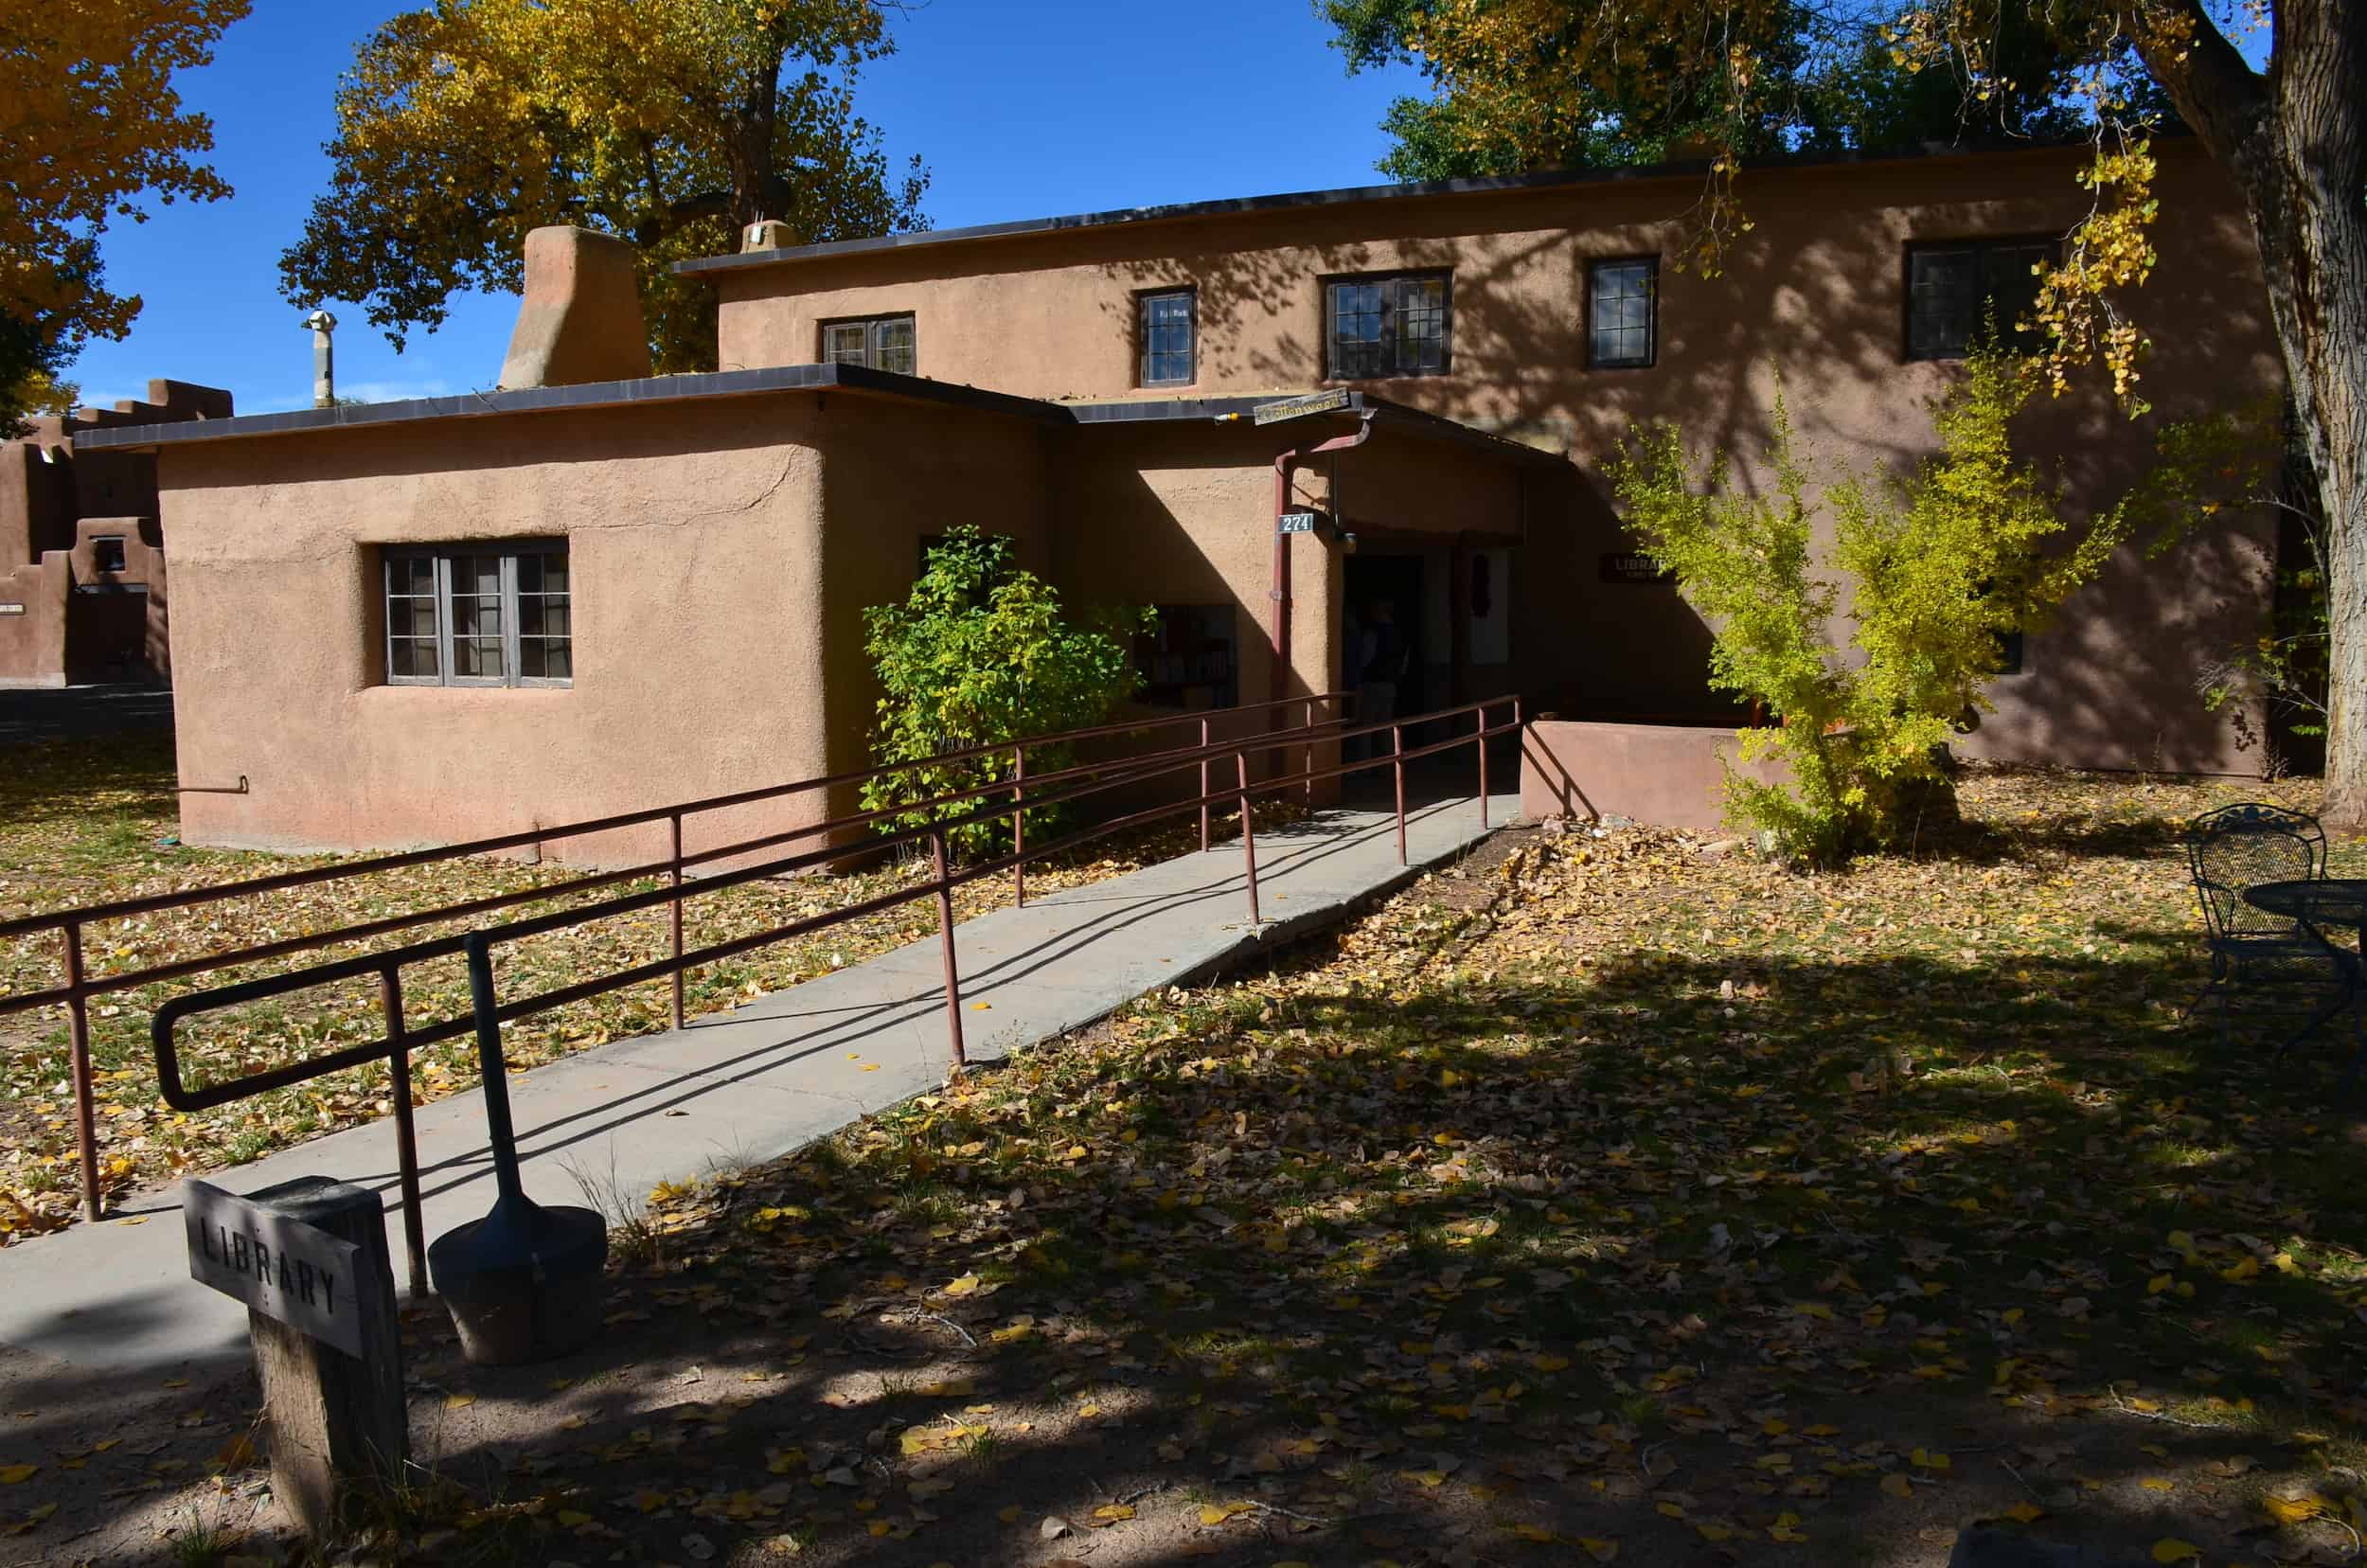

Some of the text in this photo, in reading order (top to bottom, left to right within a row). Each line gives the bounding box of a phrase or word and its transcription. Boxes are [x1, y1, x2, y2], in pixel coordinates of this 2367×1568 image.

[1283, 514, 1308, 530] 274
[1614, 558, 1666, 570] LIBRAR
[201, 1218, 333, 1314] LIBRARY
